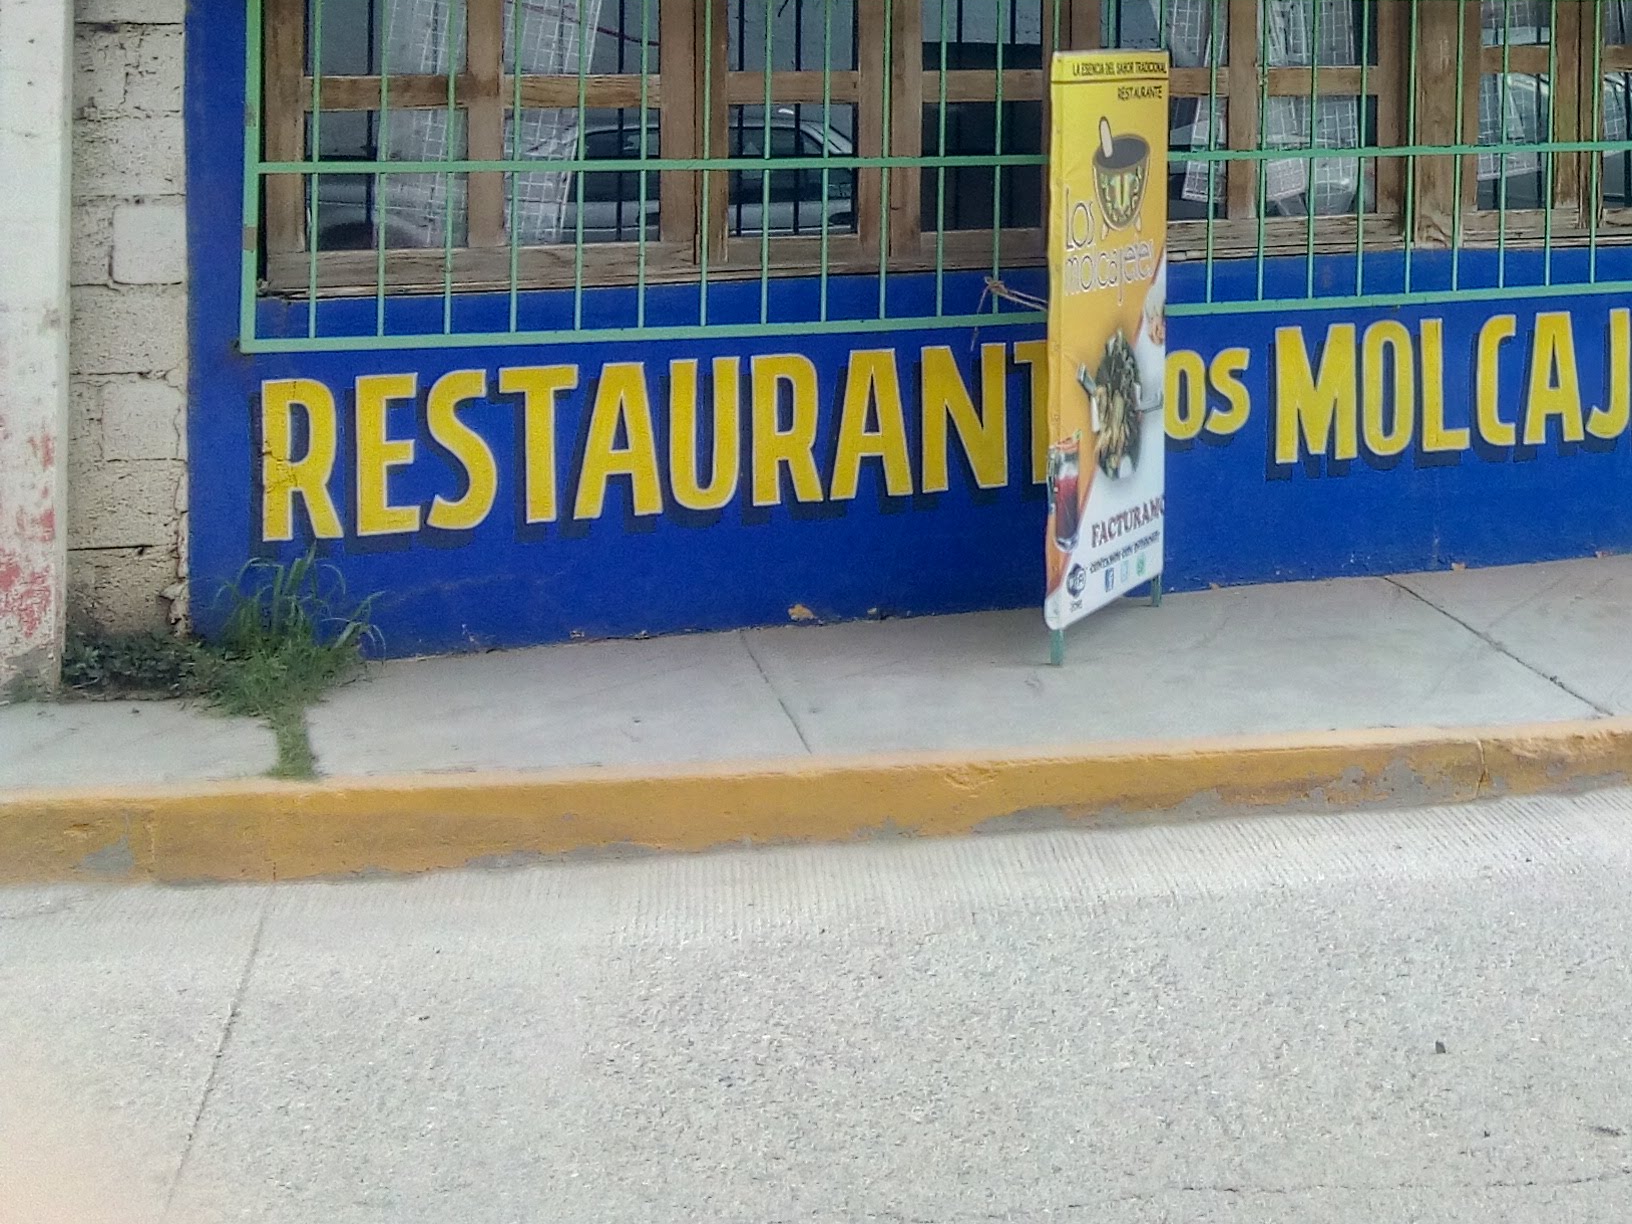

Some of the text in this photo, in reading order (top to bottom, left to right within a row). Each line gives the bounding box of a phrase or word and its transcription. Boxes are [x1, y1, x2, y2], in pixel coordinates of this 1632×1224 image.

[1073, 63, 1080, 76] LA
[1105, 62, 1115, 75] DEL
[1116, 61, 1134, 74] SABOR
[1117, 85, 1163, 101] RESTAURANTE
[1163, 347, 1252, 441] OS
